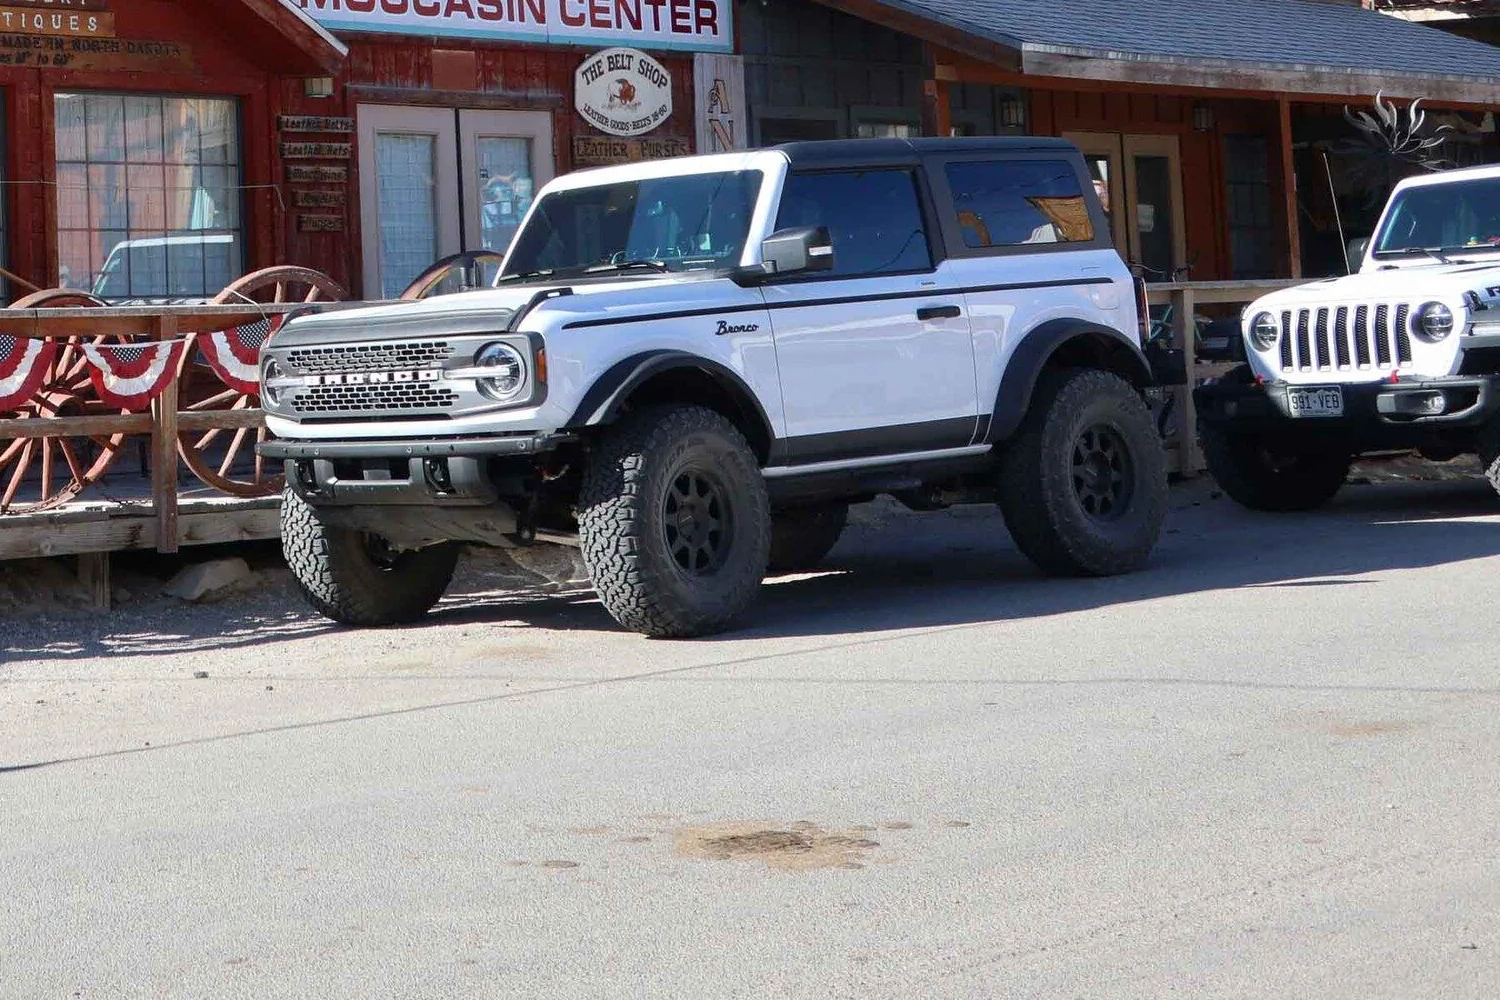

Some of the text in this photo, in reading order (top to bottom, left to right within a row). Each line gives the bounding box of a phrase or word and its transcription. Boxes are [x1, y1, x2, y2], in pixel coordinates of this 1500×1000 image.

[2, 34, 45, 50] MADE
[71, 37, 119, 54] NORTH
[582, 53, 668, 89] THE BELT SHOP
[583, 103, 609, 128] LEATHER
[610, 119, 630, 132] GOODS
[632, 117, 651, 131] BELTS
[575, 139, 687, 160] LEATHER PURSES
[715, 320, 759, 335] Bronco
[304, 370, 439, 386] BRONCO
